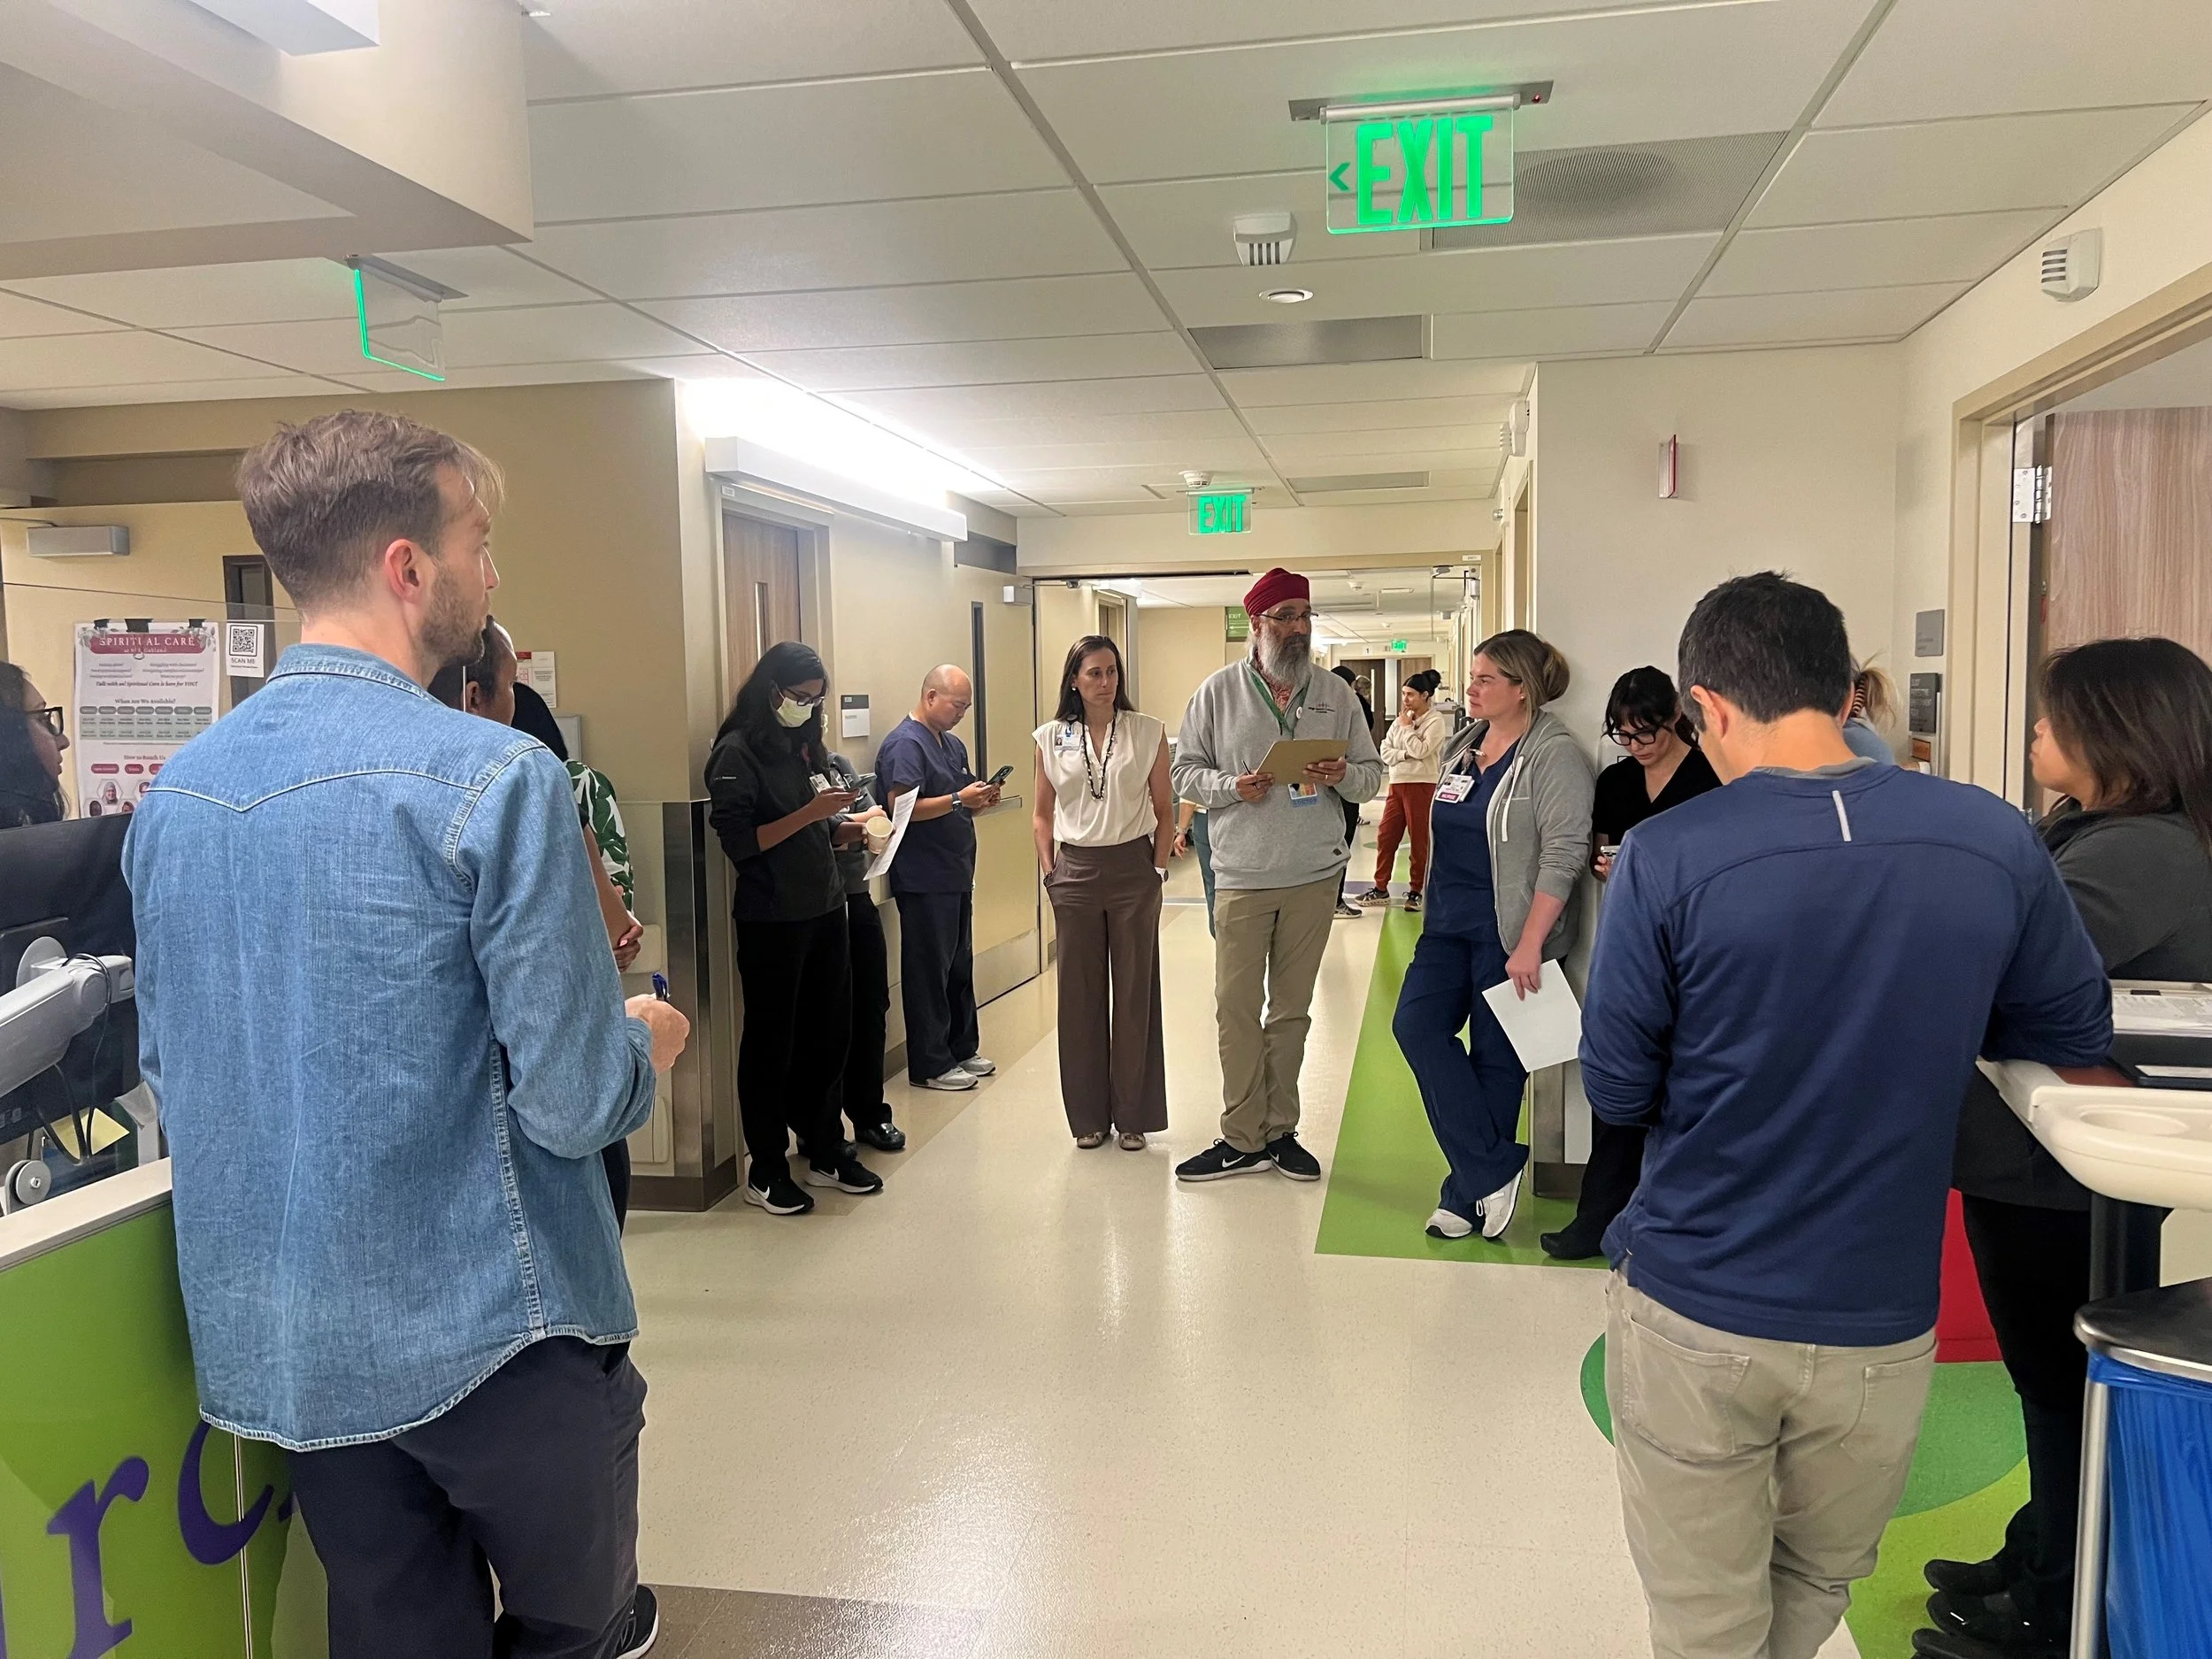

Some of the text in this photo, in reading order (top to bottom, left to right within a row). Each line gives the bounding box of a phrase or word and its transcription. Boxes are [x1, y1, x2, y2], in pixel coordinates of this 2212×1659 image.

[1356, 114, 1494, 226] EXIT
[1198, 493, 1247, 534] EXIT
[165, 637, 196, 646] CARE
